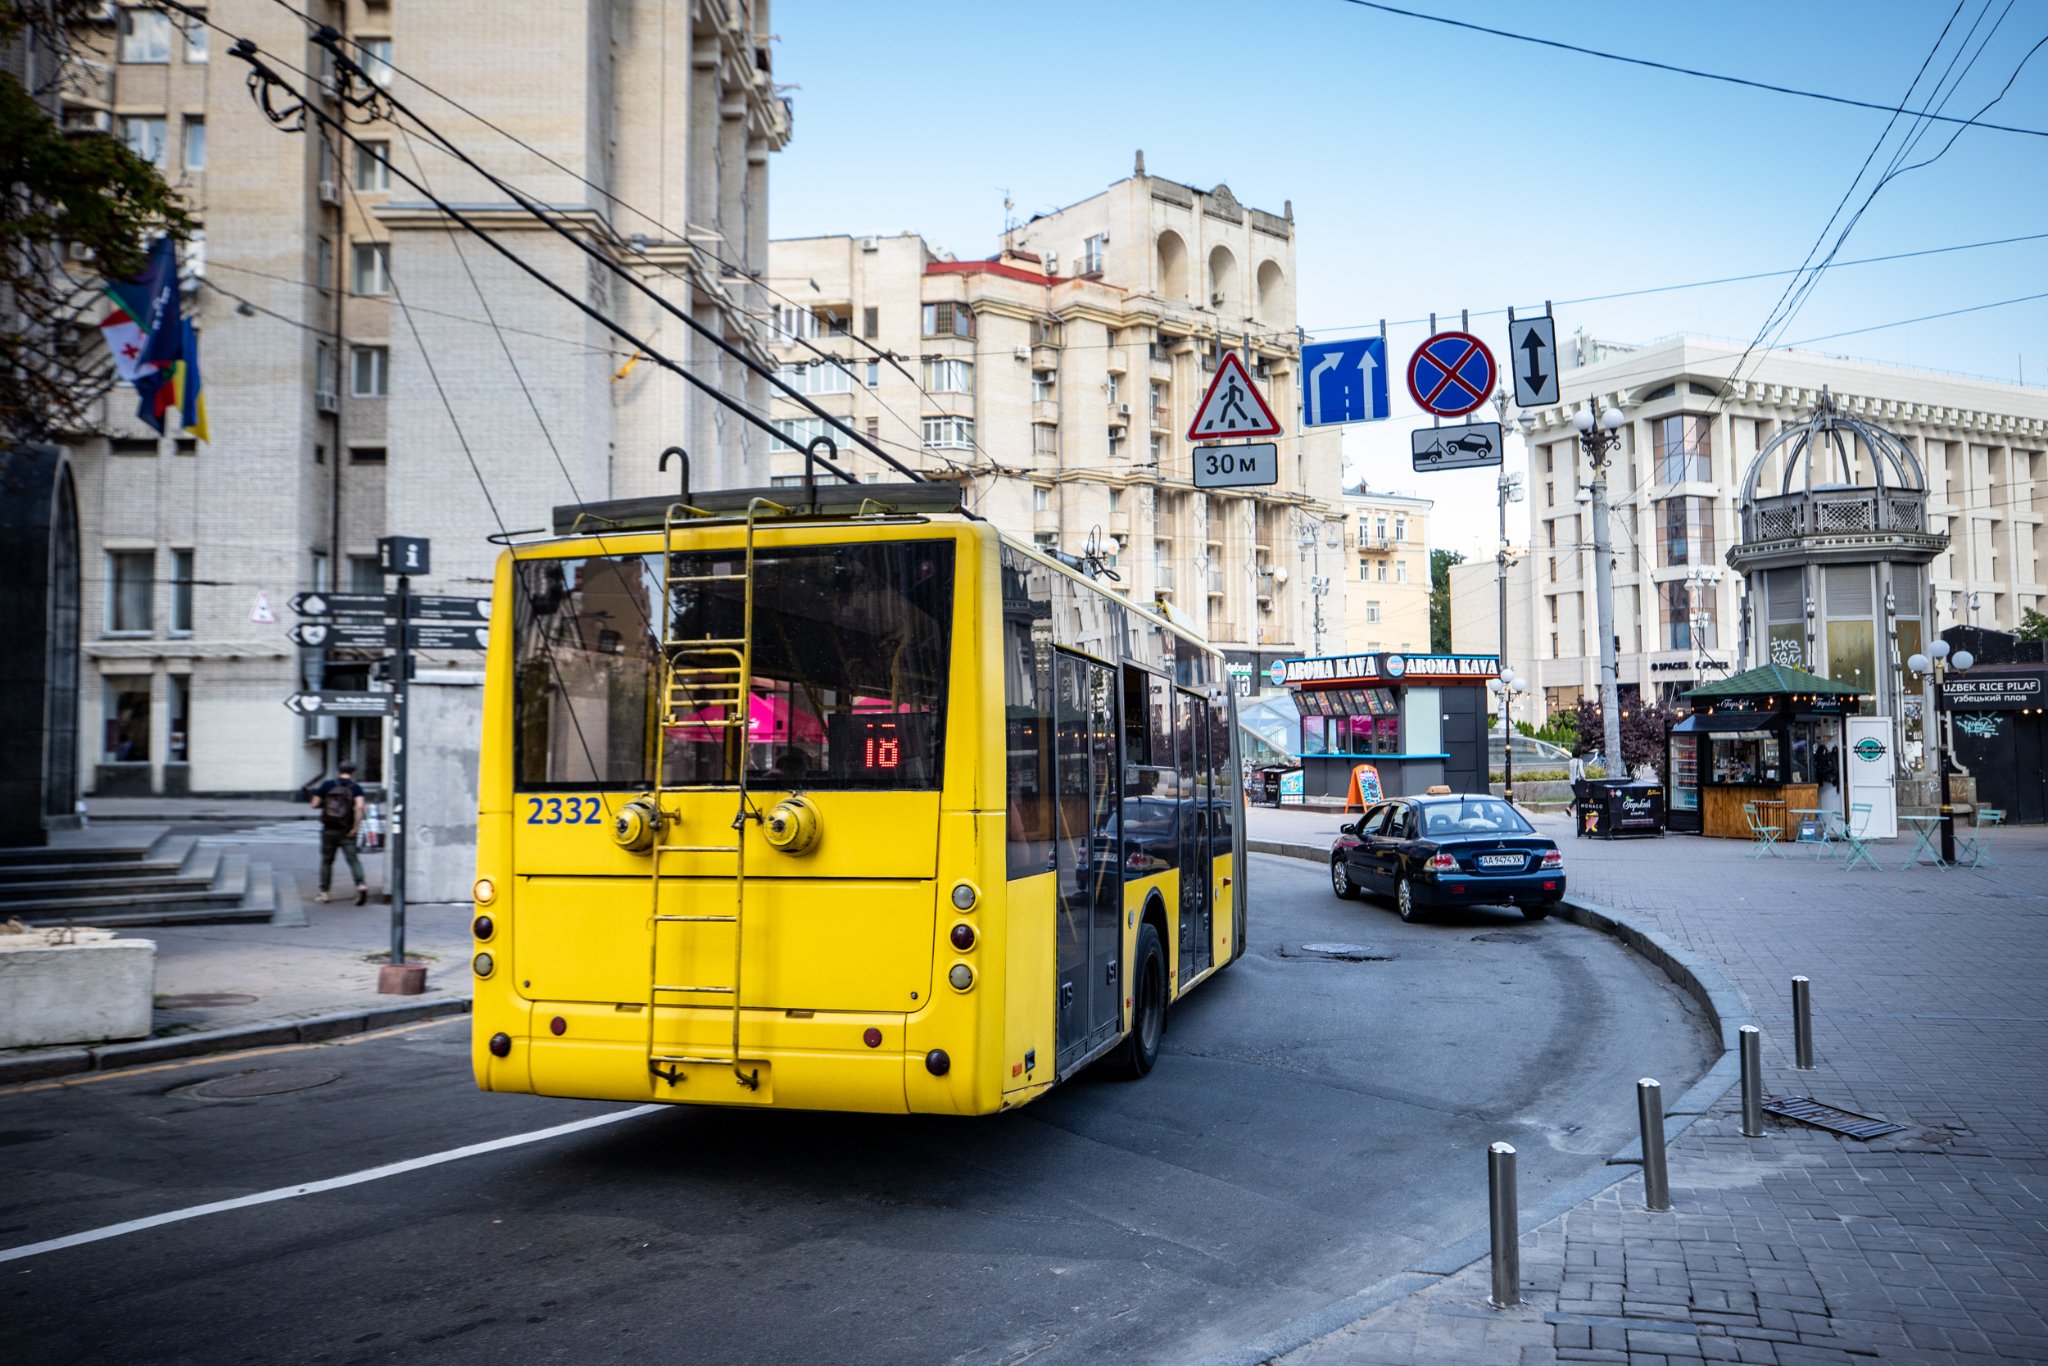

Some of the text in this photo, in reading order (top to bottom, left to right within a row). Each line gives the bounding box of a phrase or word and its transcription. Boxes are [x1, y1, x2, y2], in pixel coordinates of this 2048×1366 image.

[1206, 453, 1234, 475] 30
[1286, 655, 1377, 681] AROMA KAVA
[1405, 655, 1499, 675] AROMA KAVA
[1943, 681, 2036, 692] UZBEK RICE PILAF
[1953, 694, 2027, 704] узбецький плов
[866, 723, 898, 768] 18
[527, 797, 602, 824] 2332
[1483, 856, 1494, 865] AA
[1512, 855, 1523, 864] XK
